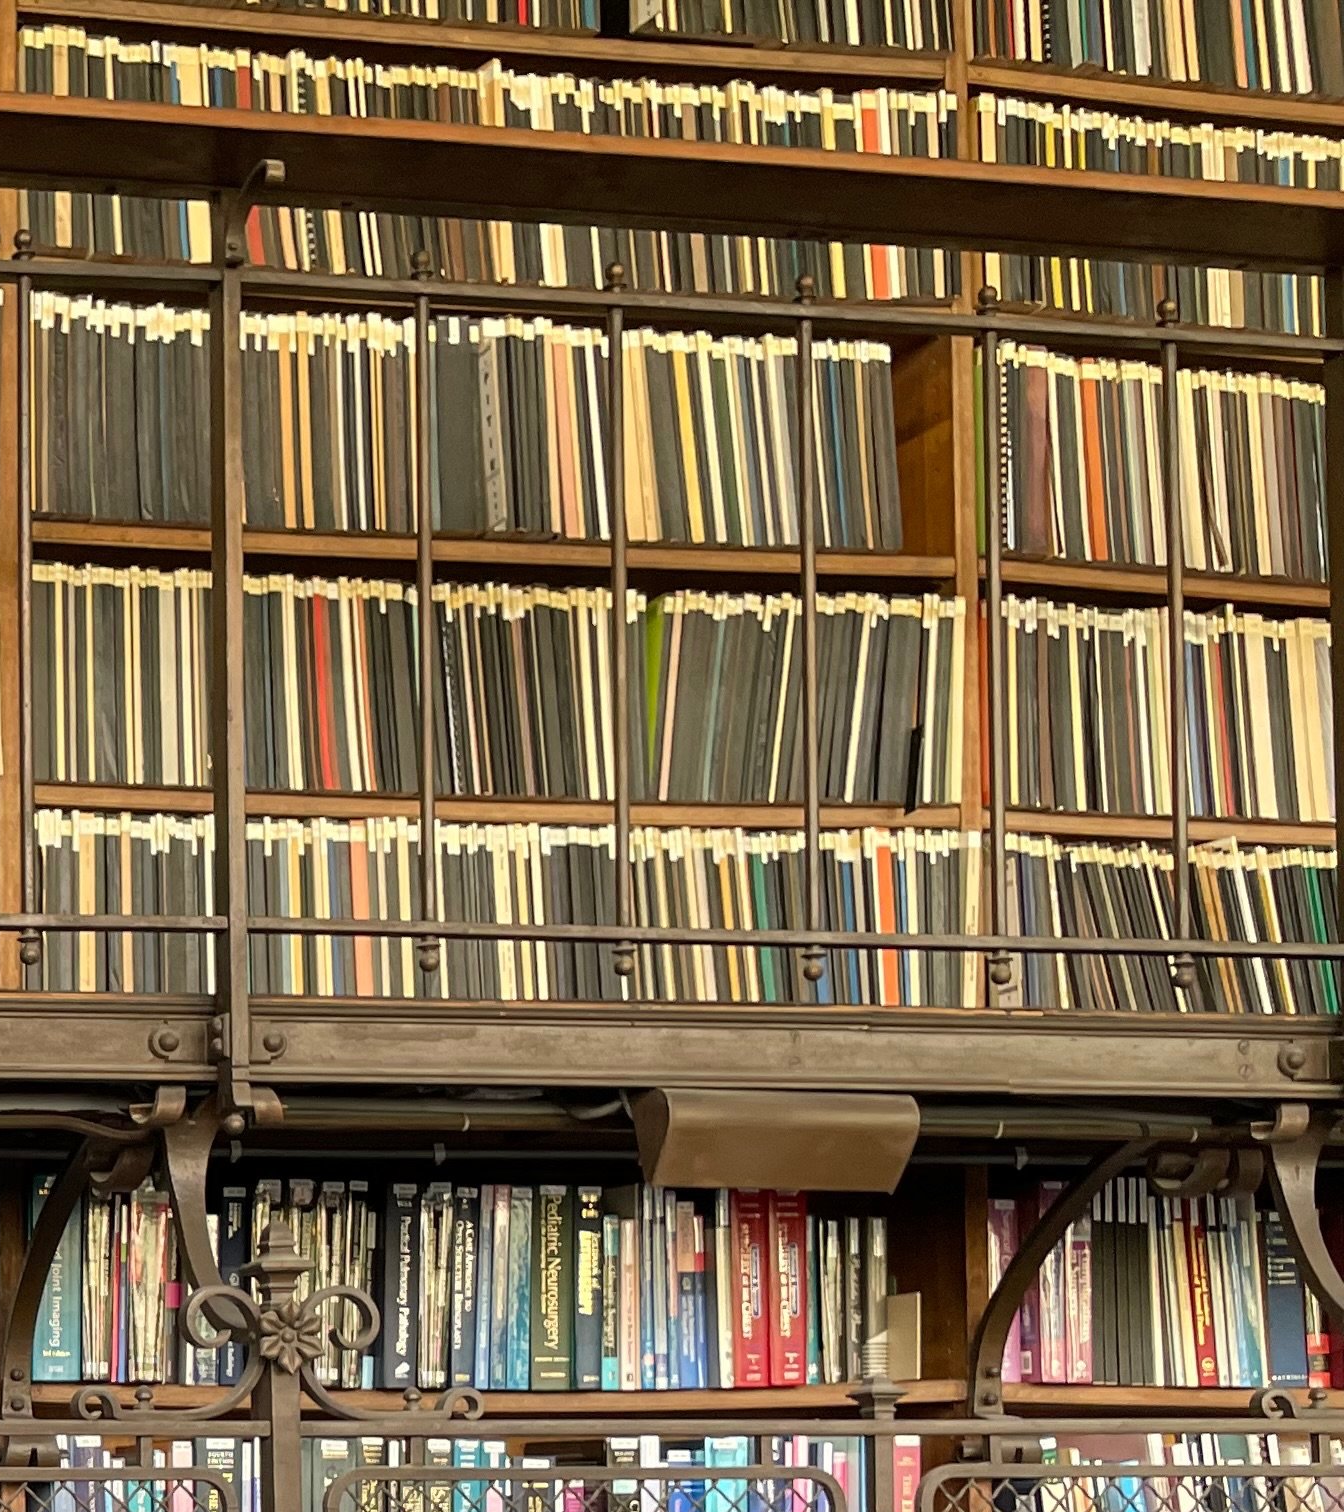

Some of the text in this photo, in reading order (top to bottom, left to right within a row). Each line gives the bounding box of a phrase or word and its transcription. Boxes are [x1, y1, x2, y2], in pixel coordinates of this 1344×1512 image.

[45, 1262, 64, 1348] Joint Imaging
[544, 1195, 563, 1349] Pediatric Neurosurgery
